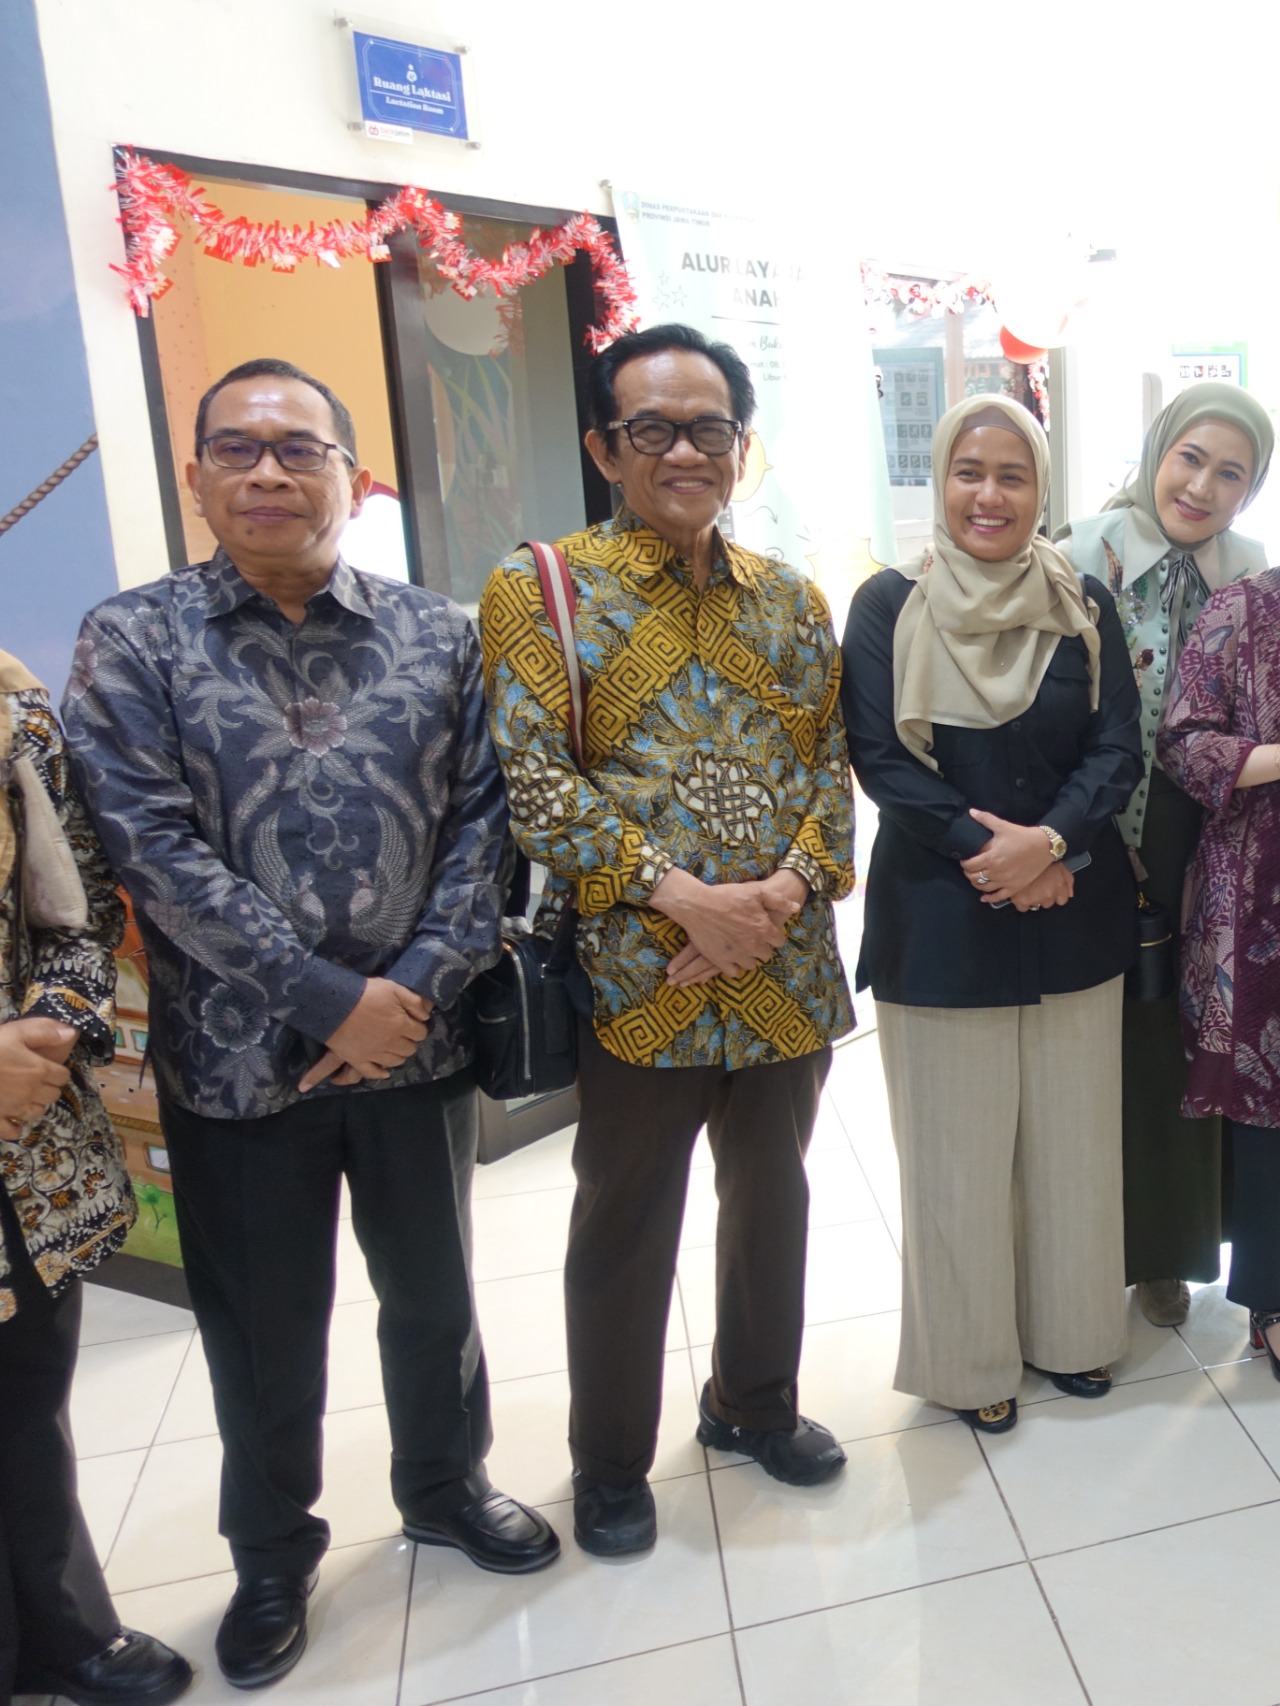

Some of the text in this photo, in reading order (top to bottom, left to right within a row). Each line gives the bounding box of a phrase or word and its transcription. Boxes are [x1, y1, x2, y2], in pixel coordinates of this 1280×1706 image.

[373, 76, 451, 102] Ruang Laktasi
[386, 96, 444, 115] Lactation Room
[641, 201, 661, 211] DINAS
[662, 204, 710, 217] PERPUSTAKAAN
[642, 211, 710, 227] PROVINSI JAWA TIMUR
[681, 252, 731, 274] ALUR
